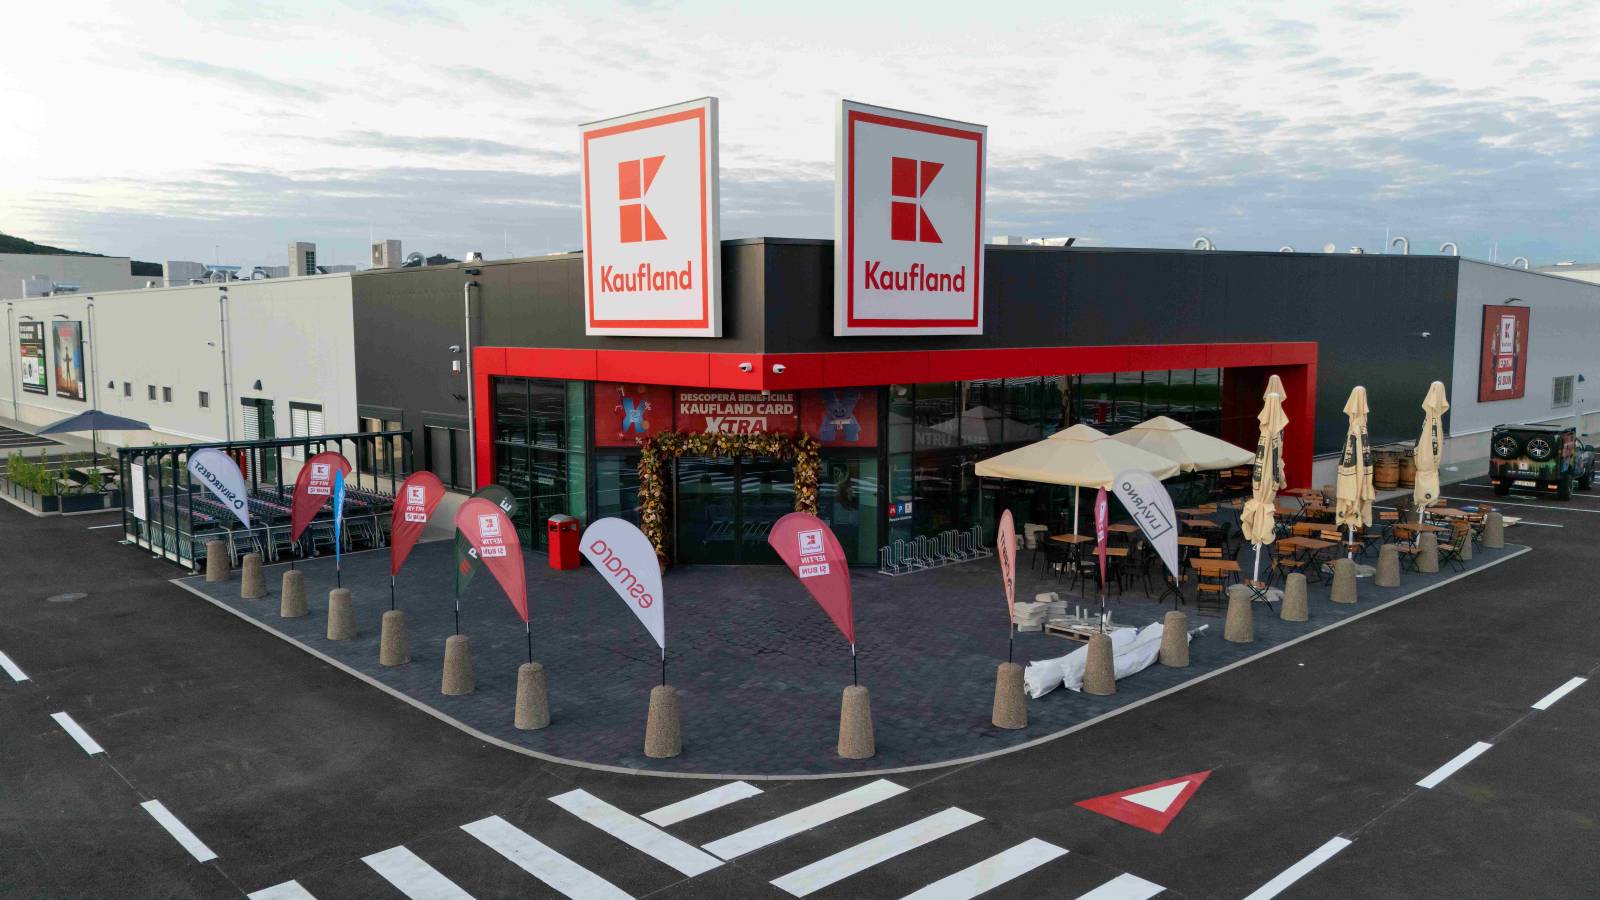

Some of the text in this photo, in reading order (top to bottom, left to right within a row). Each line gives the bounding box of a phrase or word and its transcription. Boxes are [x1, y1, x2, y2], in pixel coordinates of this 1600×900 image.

[600, 260, 692, 293] Kaufland
[864, 260, 966, 293] Kaufland
[680, 392, 737, 402] DESCOPERĂ
[680, 403, 794, 415] KAUFLAND CARD
[704, 416, 767, 435] XTRA
